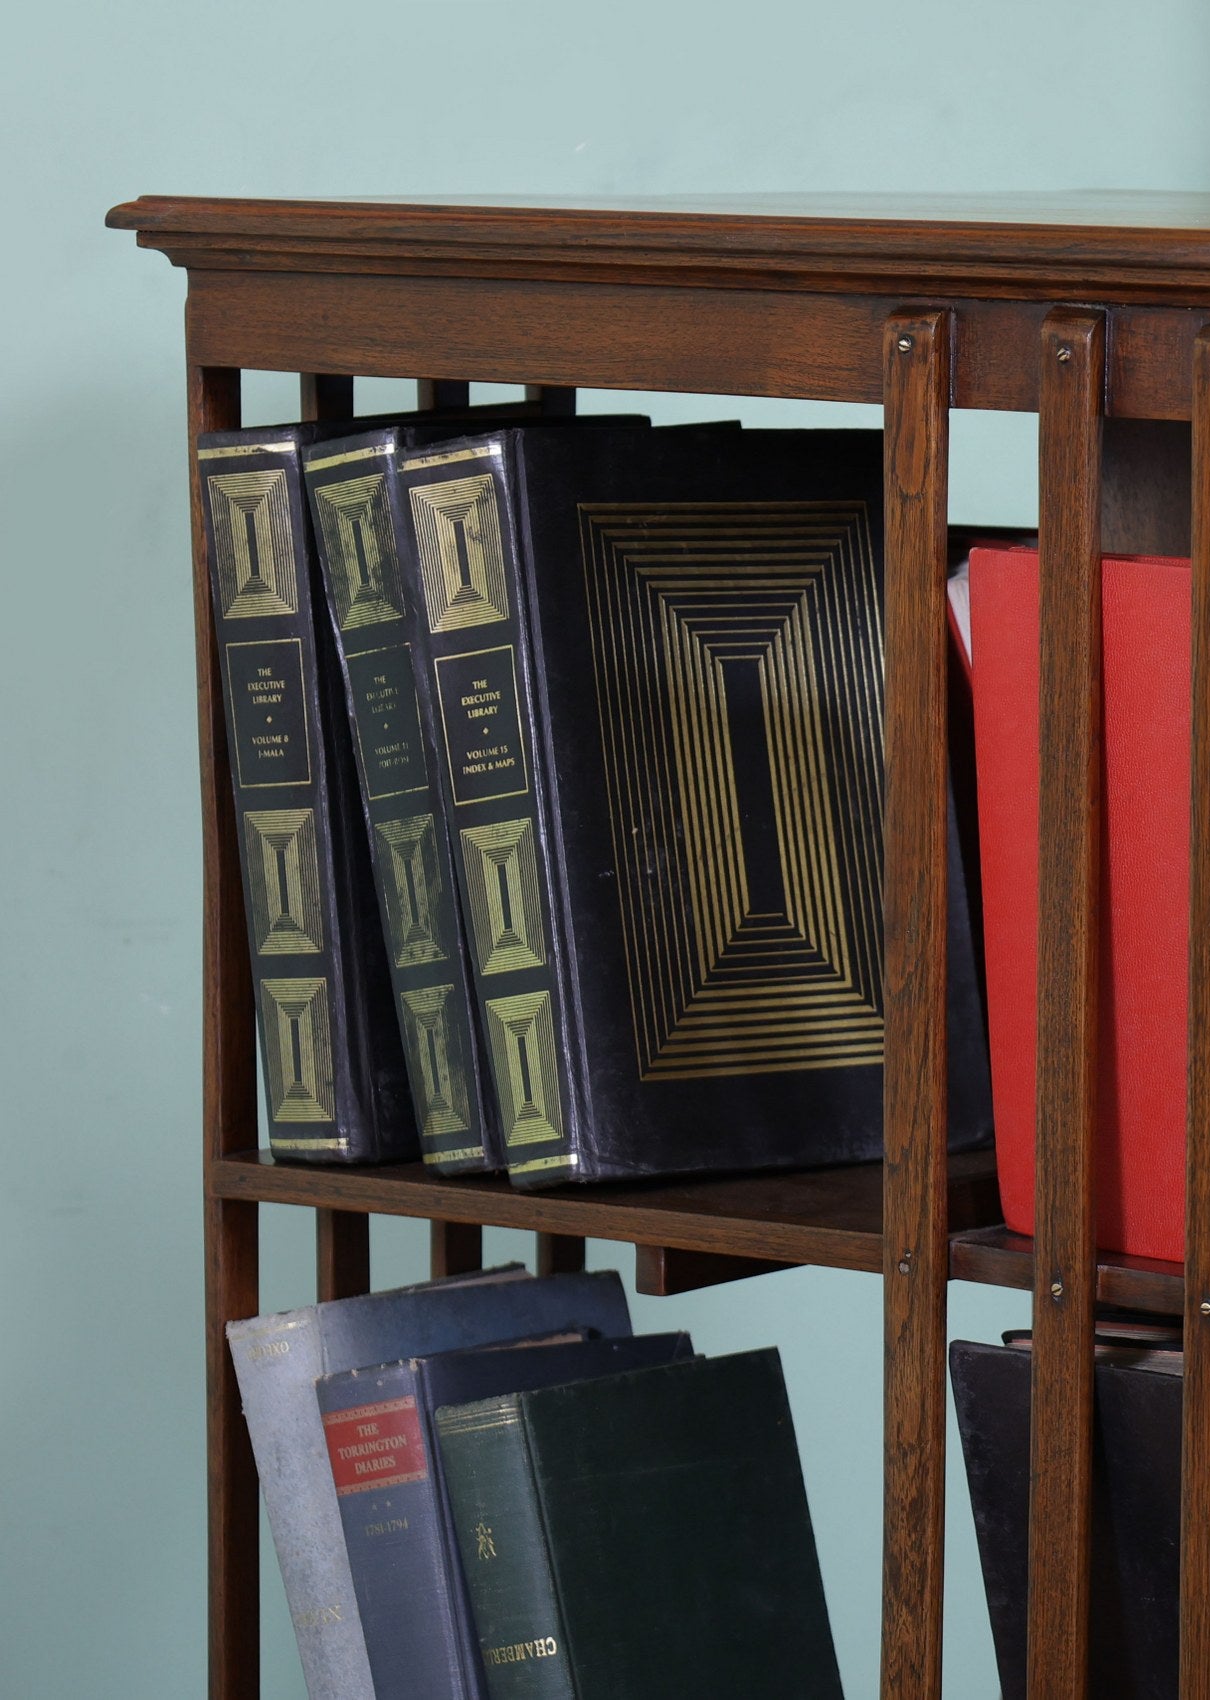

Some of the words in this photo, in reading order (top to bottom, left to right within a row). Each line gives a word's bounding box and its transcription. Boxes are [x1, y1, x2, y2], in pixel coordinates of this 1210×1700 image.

[257, 667, 272, 677] THE
[247, 680, 286, 691] EXECUTIVE
[472, 679, 488, 690] THE
[252, 694, 282, 704] LIBRARY
[461, 691, 501, 706] EXECUTIVE
[467, 705, 498, 719] LIBRARY
[252, 735, 282, 745] VOLUME
[284, 734, 289, 743] 8
[466, 747, 499, 760] VOLUME
[463, 763, 487, 775] INDEX
[495, 758, 515, 769] MAPS
[356, 1422, 380, 1438] THE
[337, 1434, 408, 1461] TORRINGTON
[354, 1455, 396, 1475] DIARIES
[484, 1636, 557, 1665] CHAMBER
